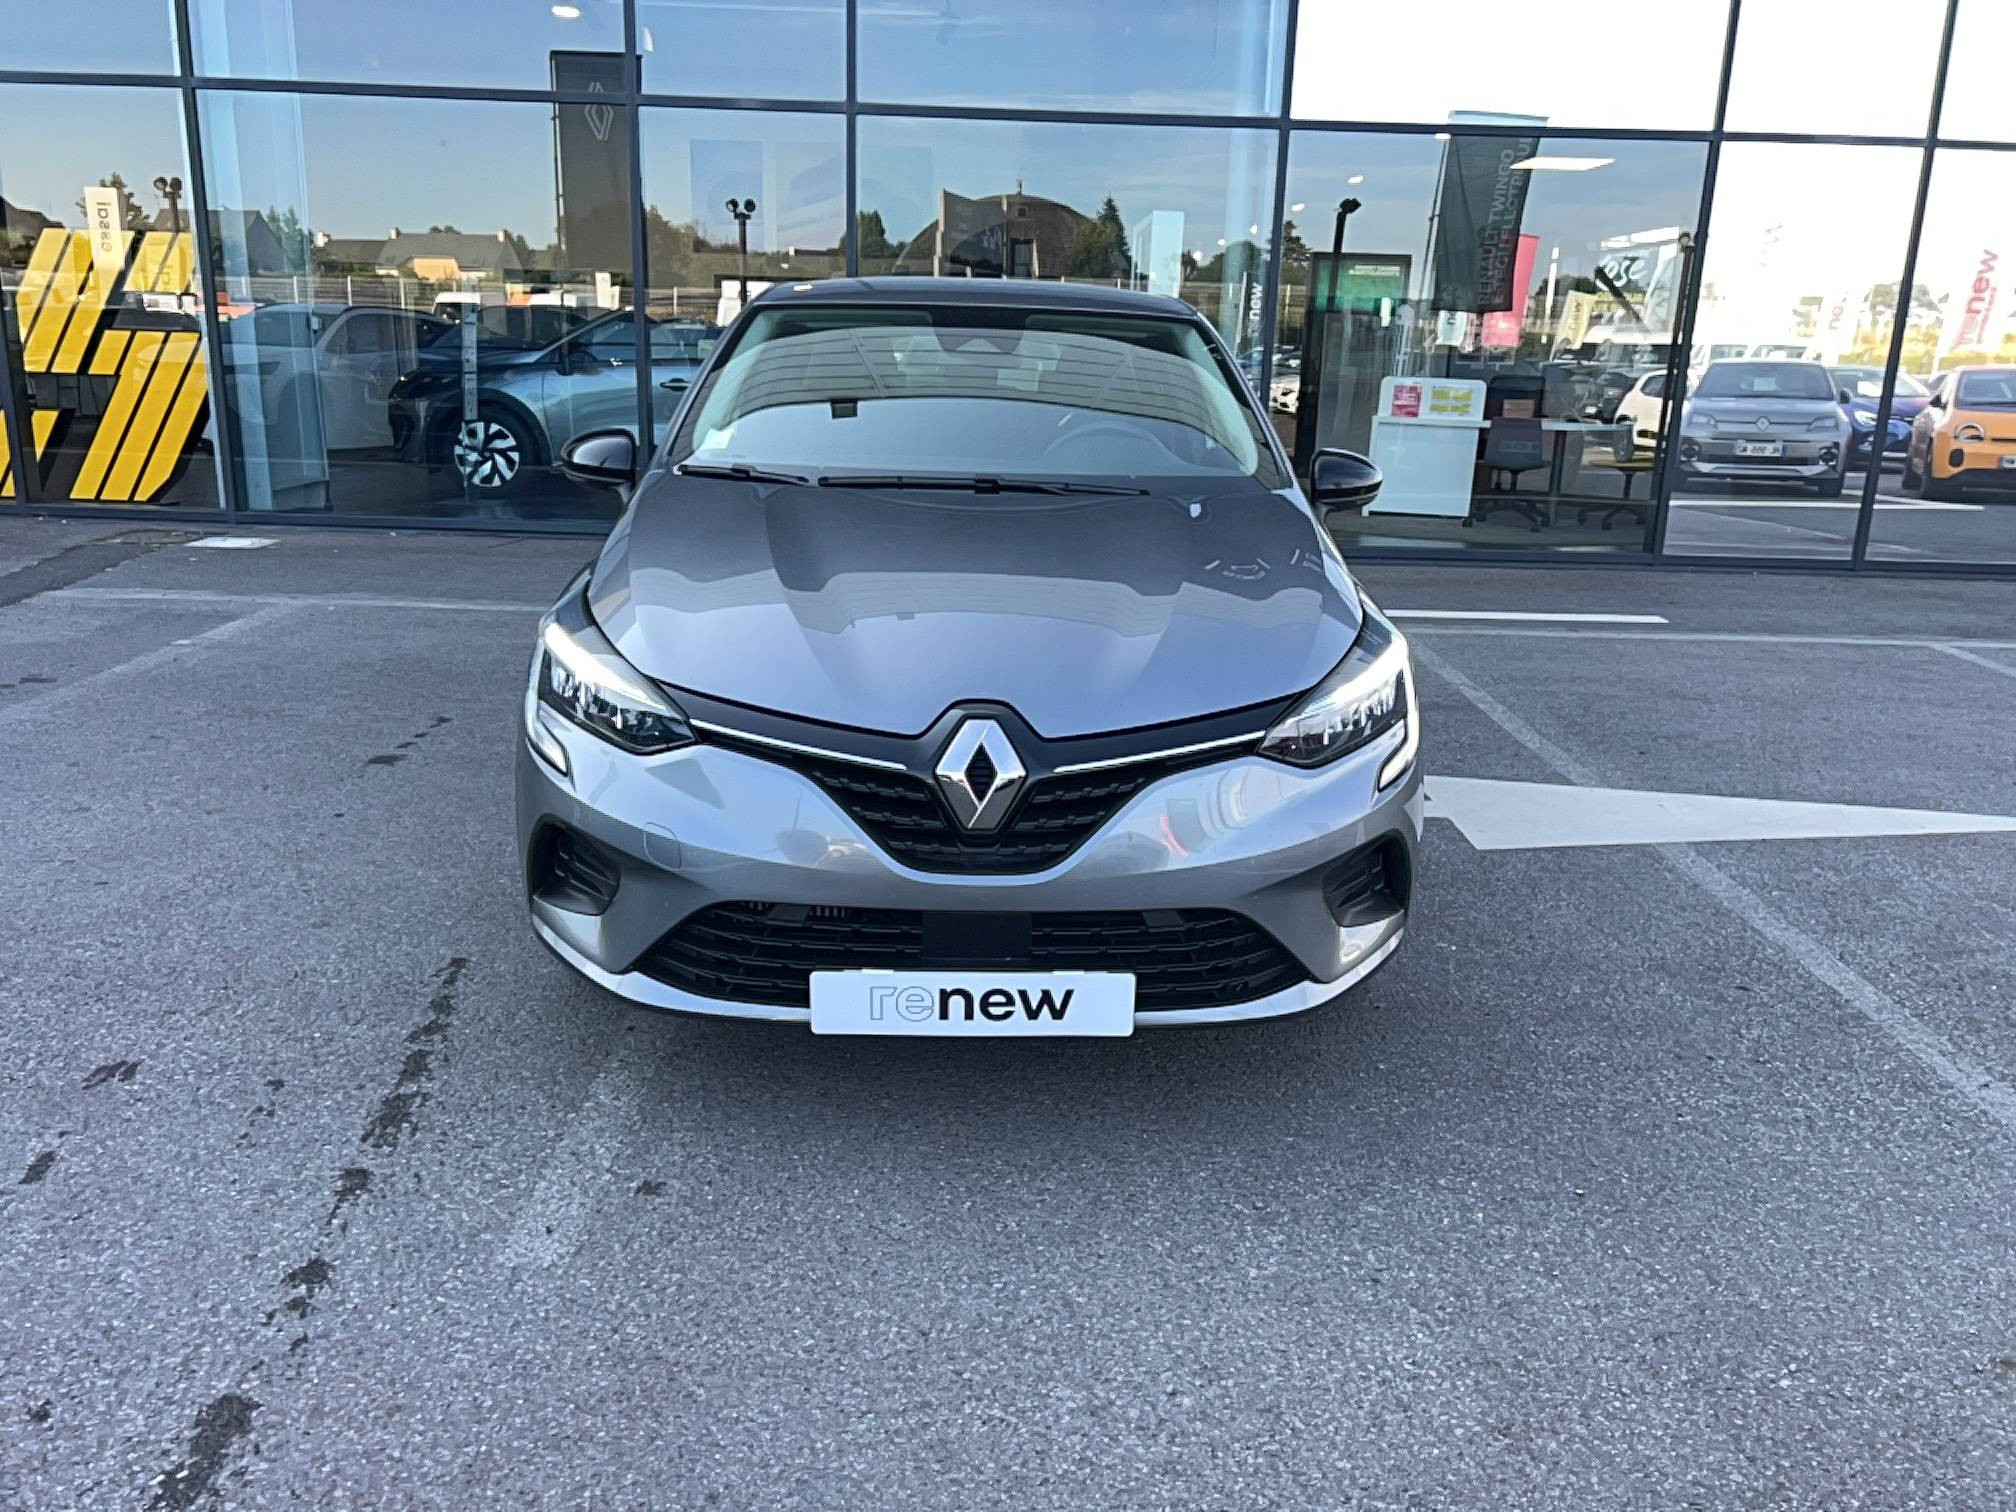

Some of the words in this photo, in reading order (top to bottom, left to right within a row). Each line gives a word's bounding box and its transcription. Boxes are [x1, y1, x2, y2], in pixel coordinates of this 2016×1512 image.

[1488, 149, 1515, 224] TWINGO
[1478, 226, 1500, 305] RENAULT
[869, 985, 1075, 1022] renew
